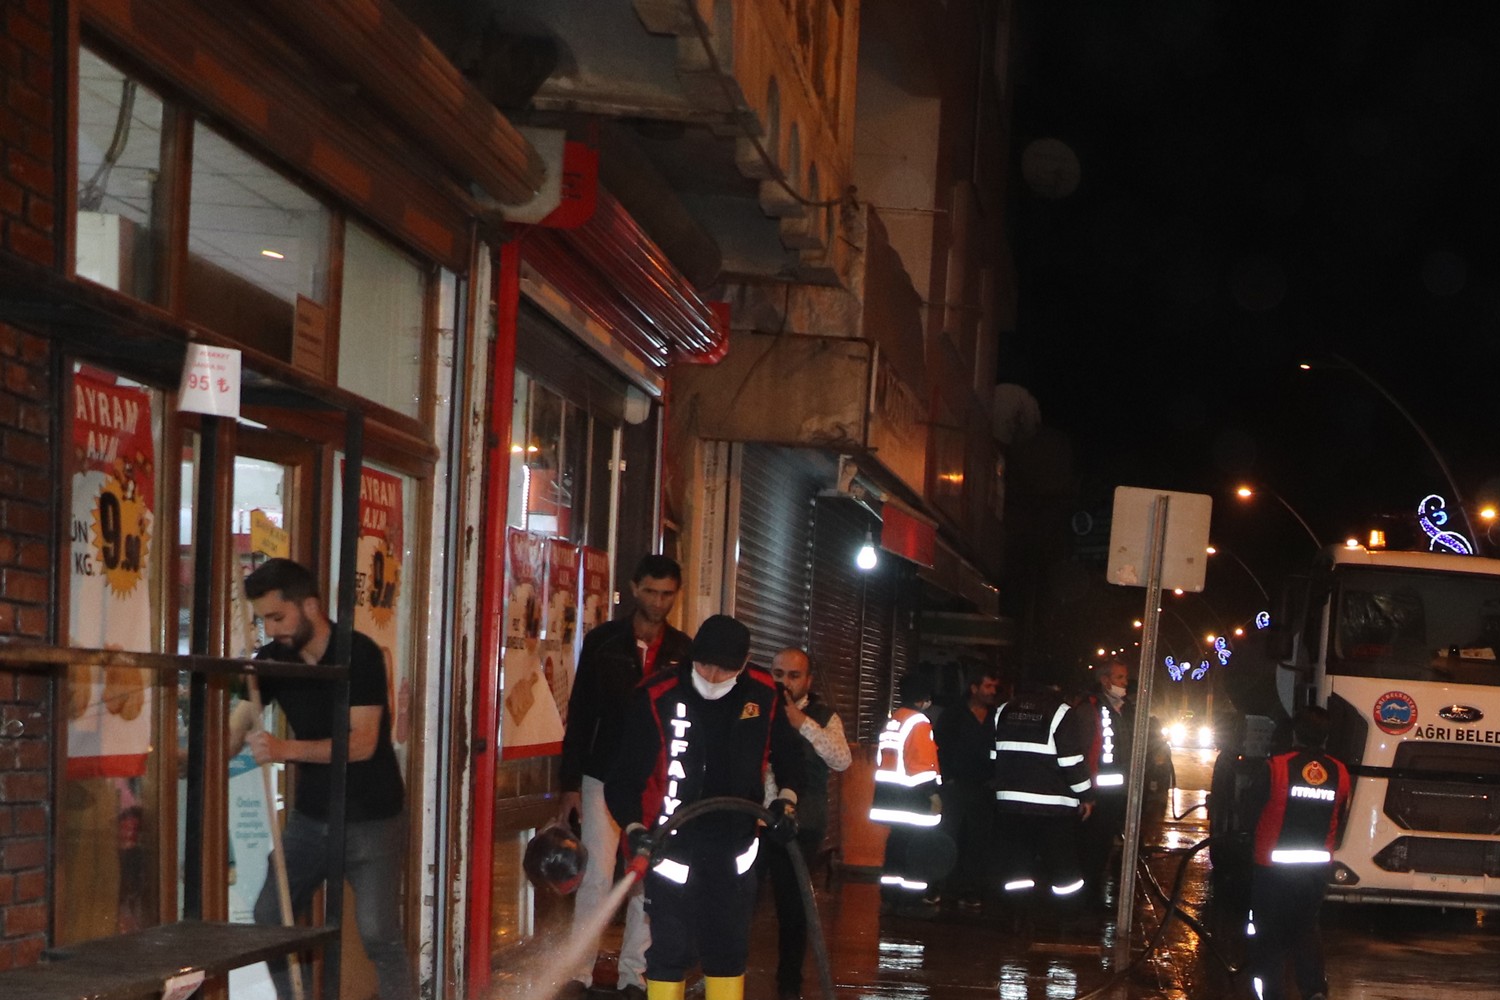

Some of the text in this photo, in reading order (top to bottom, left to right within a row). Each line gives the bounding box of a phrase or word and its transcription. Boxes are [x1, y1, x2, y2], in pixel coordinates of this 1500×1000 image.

[187, 373, 210, 391] 95
[75, 384, 139, 435] AYRAM
[360, 474, 396, 508] AYRAM
[1415, 724, 1450, 741] AĞRI
